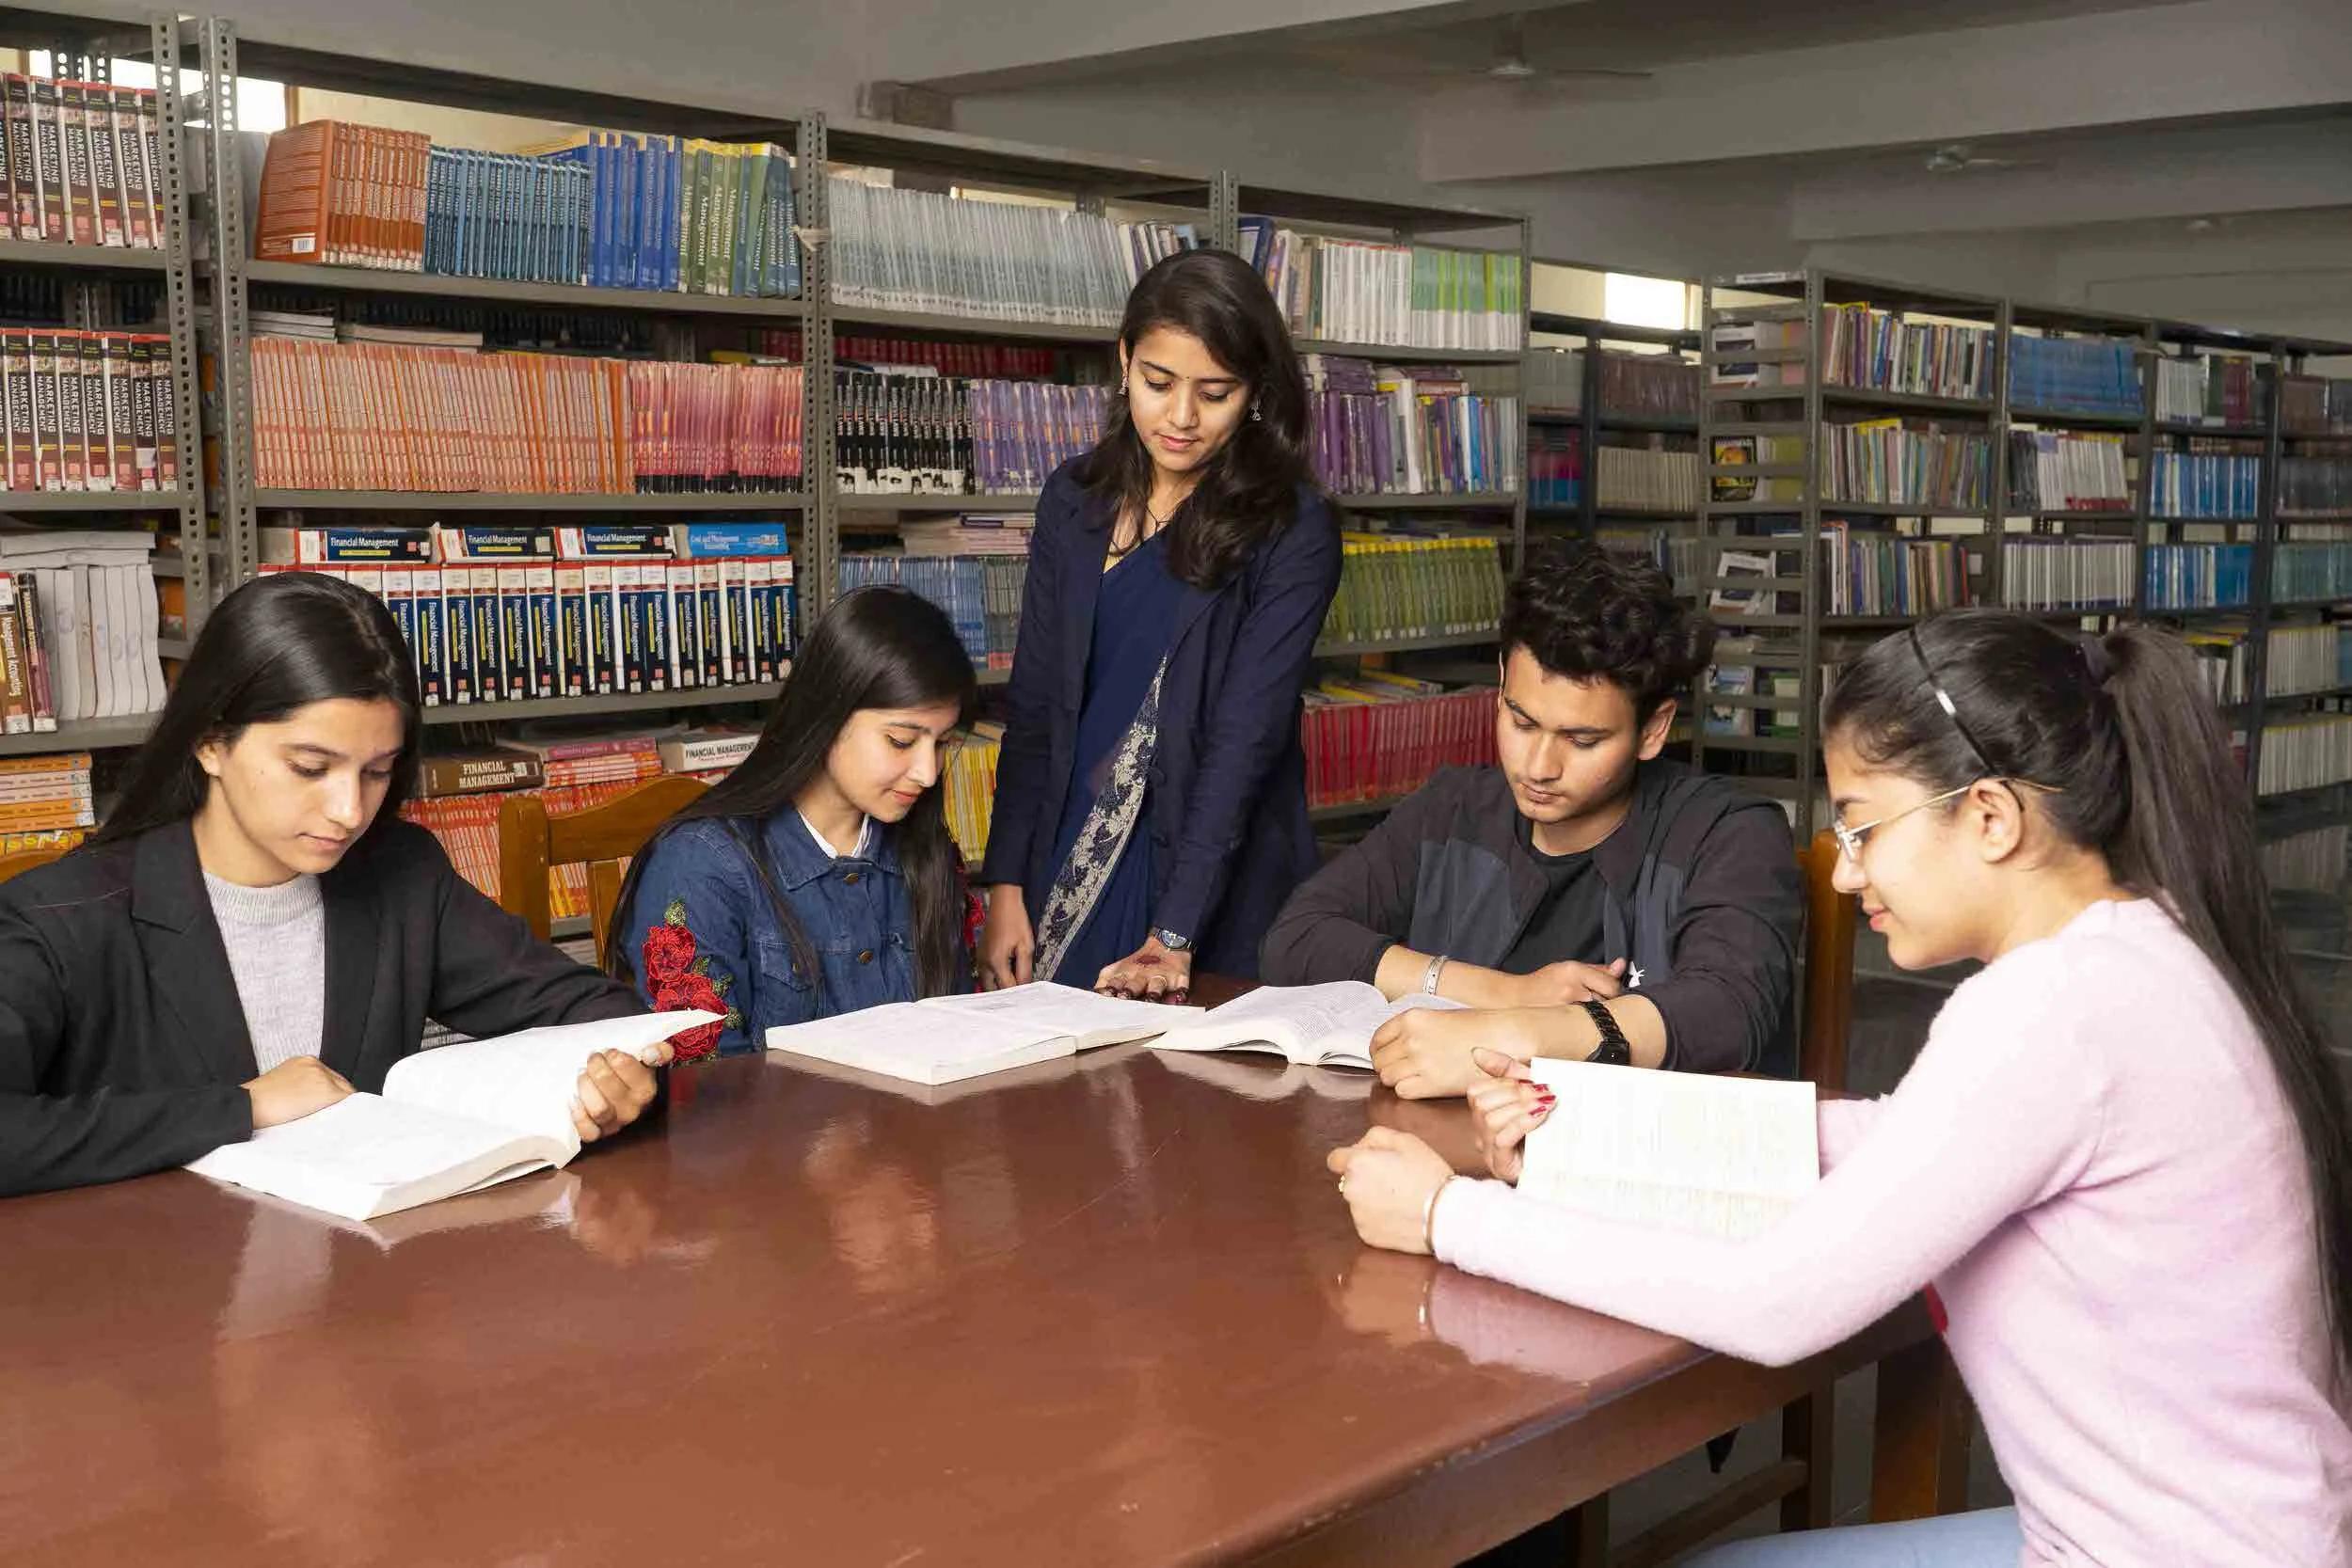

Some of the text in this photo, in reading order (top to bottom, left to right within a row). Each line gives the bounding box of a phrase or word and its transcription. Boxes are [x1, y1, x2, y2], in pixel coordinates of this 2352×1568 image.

[13, 122, 24, 181] MANAGEMENT
[21, 122, 33, 182] MARKETING
[40, 123, 51, 182] MANAGEMENT
[49, 125, 60, 183] MARKETING
[68, 127, 78, 184] MANAGEMENT
[76, 128, 87, 186] MARKETING
[93, 131, 105, 187] MANAGEMENT
[102, 131, 115, 188] MARKETING
[121, 133, 135, 188] MANAGEMENT
[130, 133, 143, 190] MARKETING
[697, 195, 708, 266] Management
[11, 376, 21, 433] MANAGEMENT
[19, 376, 30, 433] MARKETING
[37, 376, 47, 432] MANAGEMENT
[45, 376, 56, 433] MARKETING
[61, 376, 72, 433] MANAGEMENT
[71, 376, 81, 434] MARKETING
[86, 378, 95, 434] MANAGEMENT
[93, 378, 105, 435] MARKETING
[112, 378, 122, 433] MANAGEMENT
[120, 378, 131, 435] MARKETING
[135, 382, 144, 436] MANAGEMENT
[142, 382, 152, 436] MARKETING
[156, 380, 166, 434] MANAGEMENT
[164, 379, 174, 435] MARKETING
[330, 537, 358, 546] Financial
[358, 537, 399, 549] Management
[469, 534, 528, 546] Financial Management
[587, 533, 646, 544] Financial Management
[429, 602, 438, 673] Financial Management
[458, 600, 468, 670] Financial Management
[485, 599, 496, 668] Financial Management
[514, 599, 524, 668] Financial Management
[542, 597, 552, 666] Financial Management
[572, 599, 582, 666] Financial Management
[602, 622, 611, 662] Management
[630, 594, 640, 662] Financial Management
[655, 594, 664, 659] Financial Management
[685, 621, 693, 659] Management
[459, 772, 516, 788] MANAGEMENT
[463, 760, 506, 775] FINANCIAL
[686, 746, 716, 759] FINANCIAL
